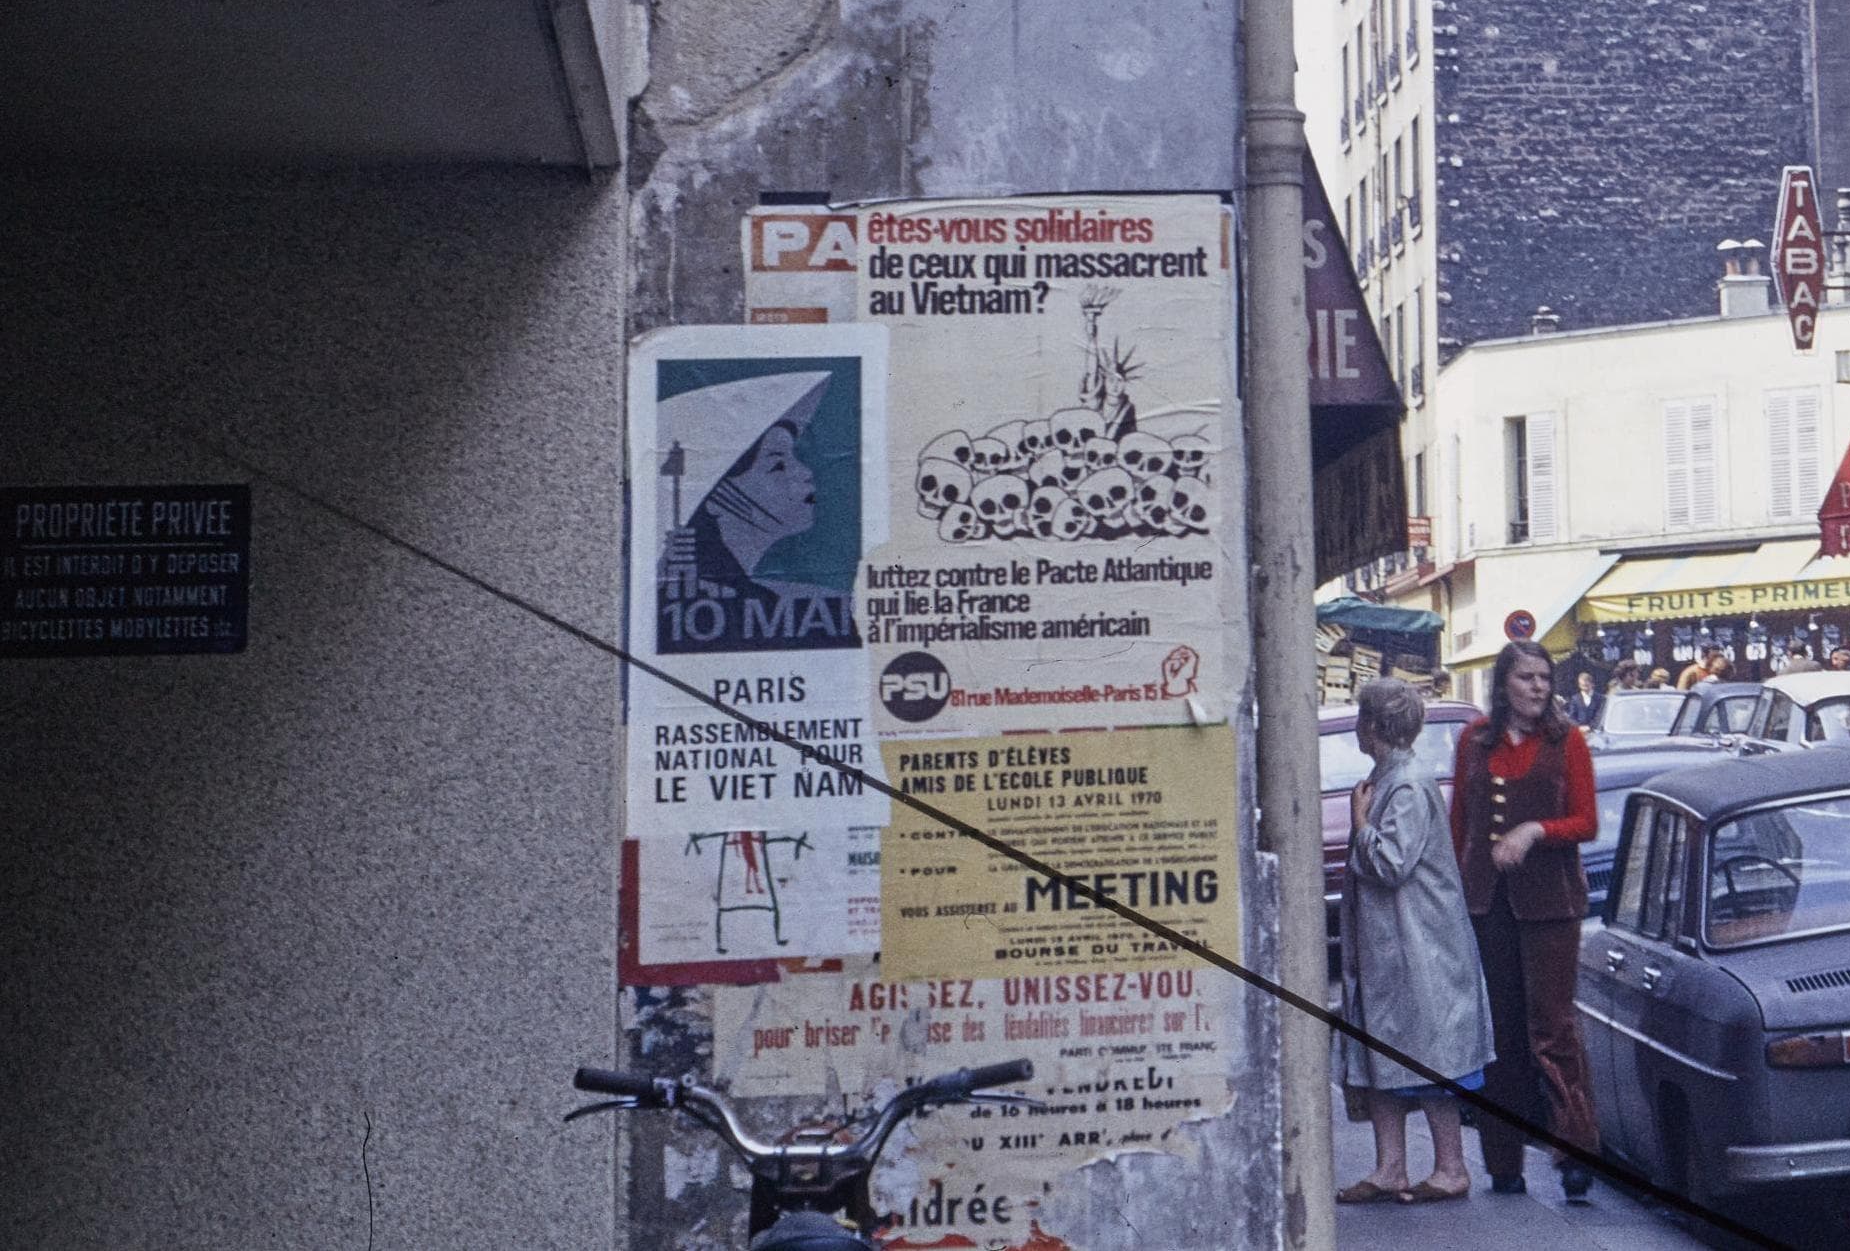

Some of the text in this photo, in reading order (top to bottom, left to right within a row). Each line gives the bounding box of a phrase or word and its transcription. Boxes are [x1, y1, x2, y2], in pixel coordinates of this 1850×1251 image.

[868, 209, 1154, 244] êtes-vous solidaires
[869, 246, 1208, 285] de ceux qui massacrent
[1786, 180, 1818, 342] TABAC
[869, 280, 1050, 316] au Vietnam?
[1308, 309, 1360, 379] IE
[867, 556, 1213, 590] luttez contre le Pacte Atlantique
[867, 588, 1031, 617] qui lie la France
[1627, 590, 1734, 614] FRUITS
[662, 597, 853, 642] 10 MAI
[867, 610, 1151, 647] à l'impérialisme américain
[714, 675, 806, 705] PARIS
[882, 671, 949, 701] PSU
[951, 688, 965, 707] 81
[968, 691, 993, 706] rue
[655, 718, 864, 747] RASSEMBLEMENT
[655, 744, 864, 772] NATIONAL POUR
[900, 749, 979, 772] PARENTS
[655, 769, 865, 803] LE VIET NAM
[900, 774, 946, 795] AMIS
[954, 773, 976, 792] DE
[1062, 766, 1149, 787] PUBLIQUE
[987, 790, 1163, 811] LUNDI 13 AVRIL 1970
[910, 865, 957, 876] POUR
[901, 905, 930, 919] VOUS
[1003, 902, 1018, 915] AU
[1026, 869, 1218, 912] MEETING
[995, 947, 1079, 960] BOURSE
[1092, 944, 1118, 956] DU
[1004, 969, 1194, 1006] UNISSEZ-VOU
[752, 1025, 794, 1059] pour
[804, 1018, 861, 1048] briser
[970, 1105, 992, 1119] de
[1116, 1096, 1134, 1112] 18
[1142, 1096, 1201, 1111] heures
